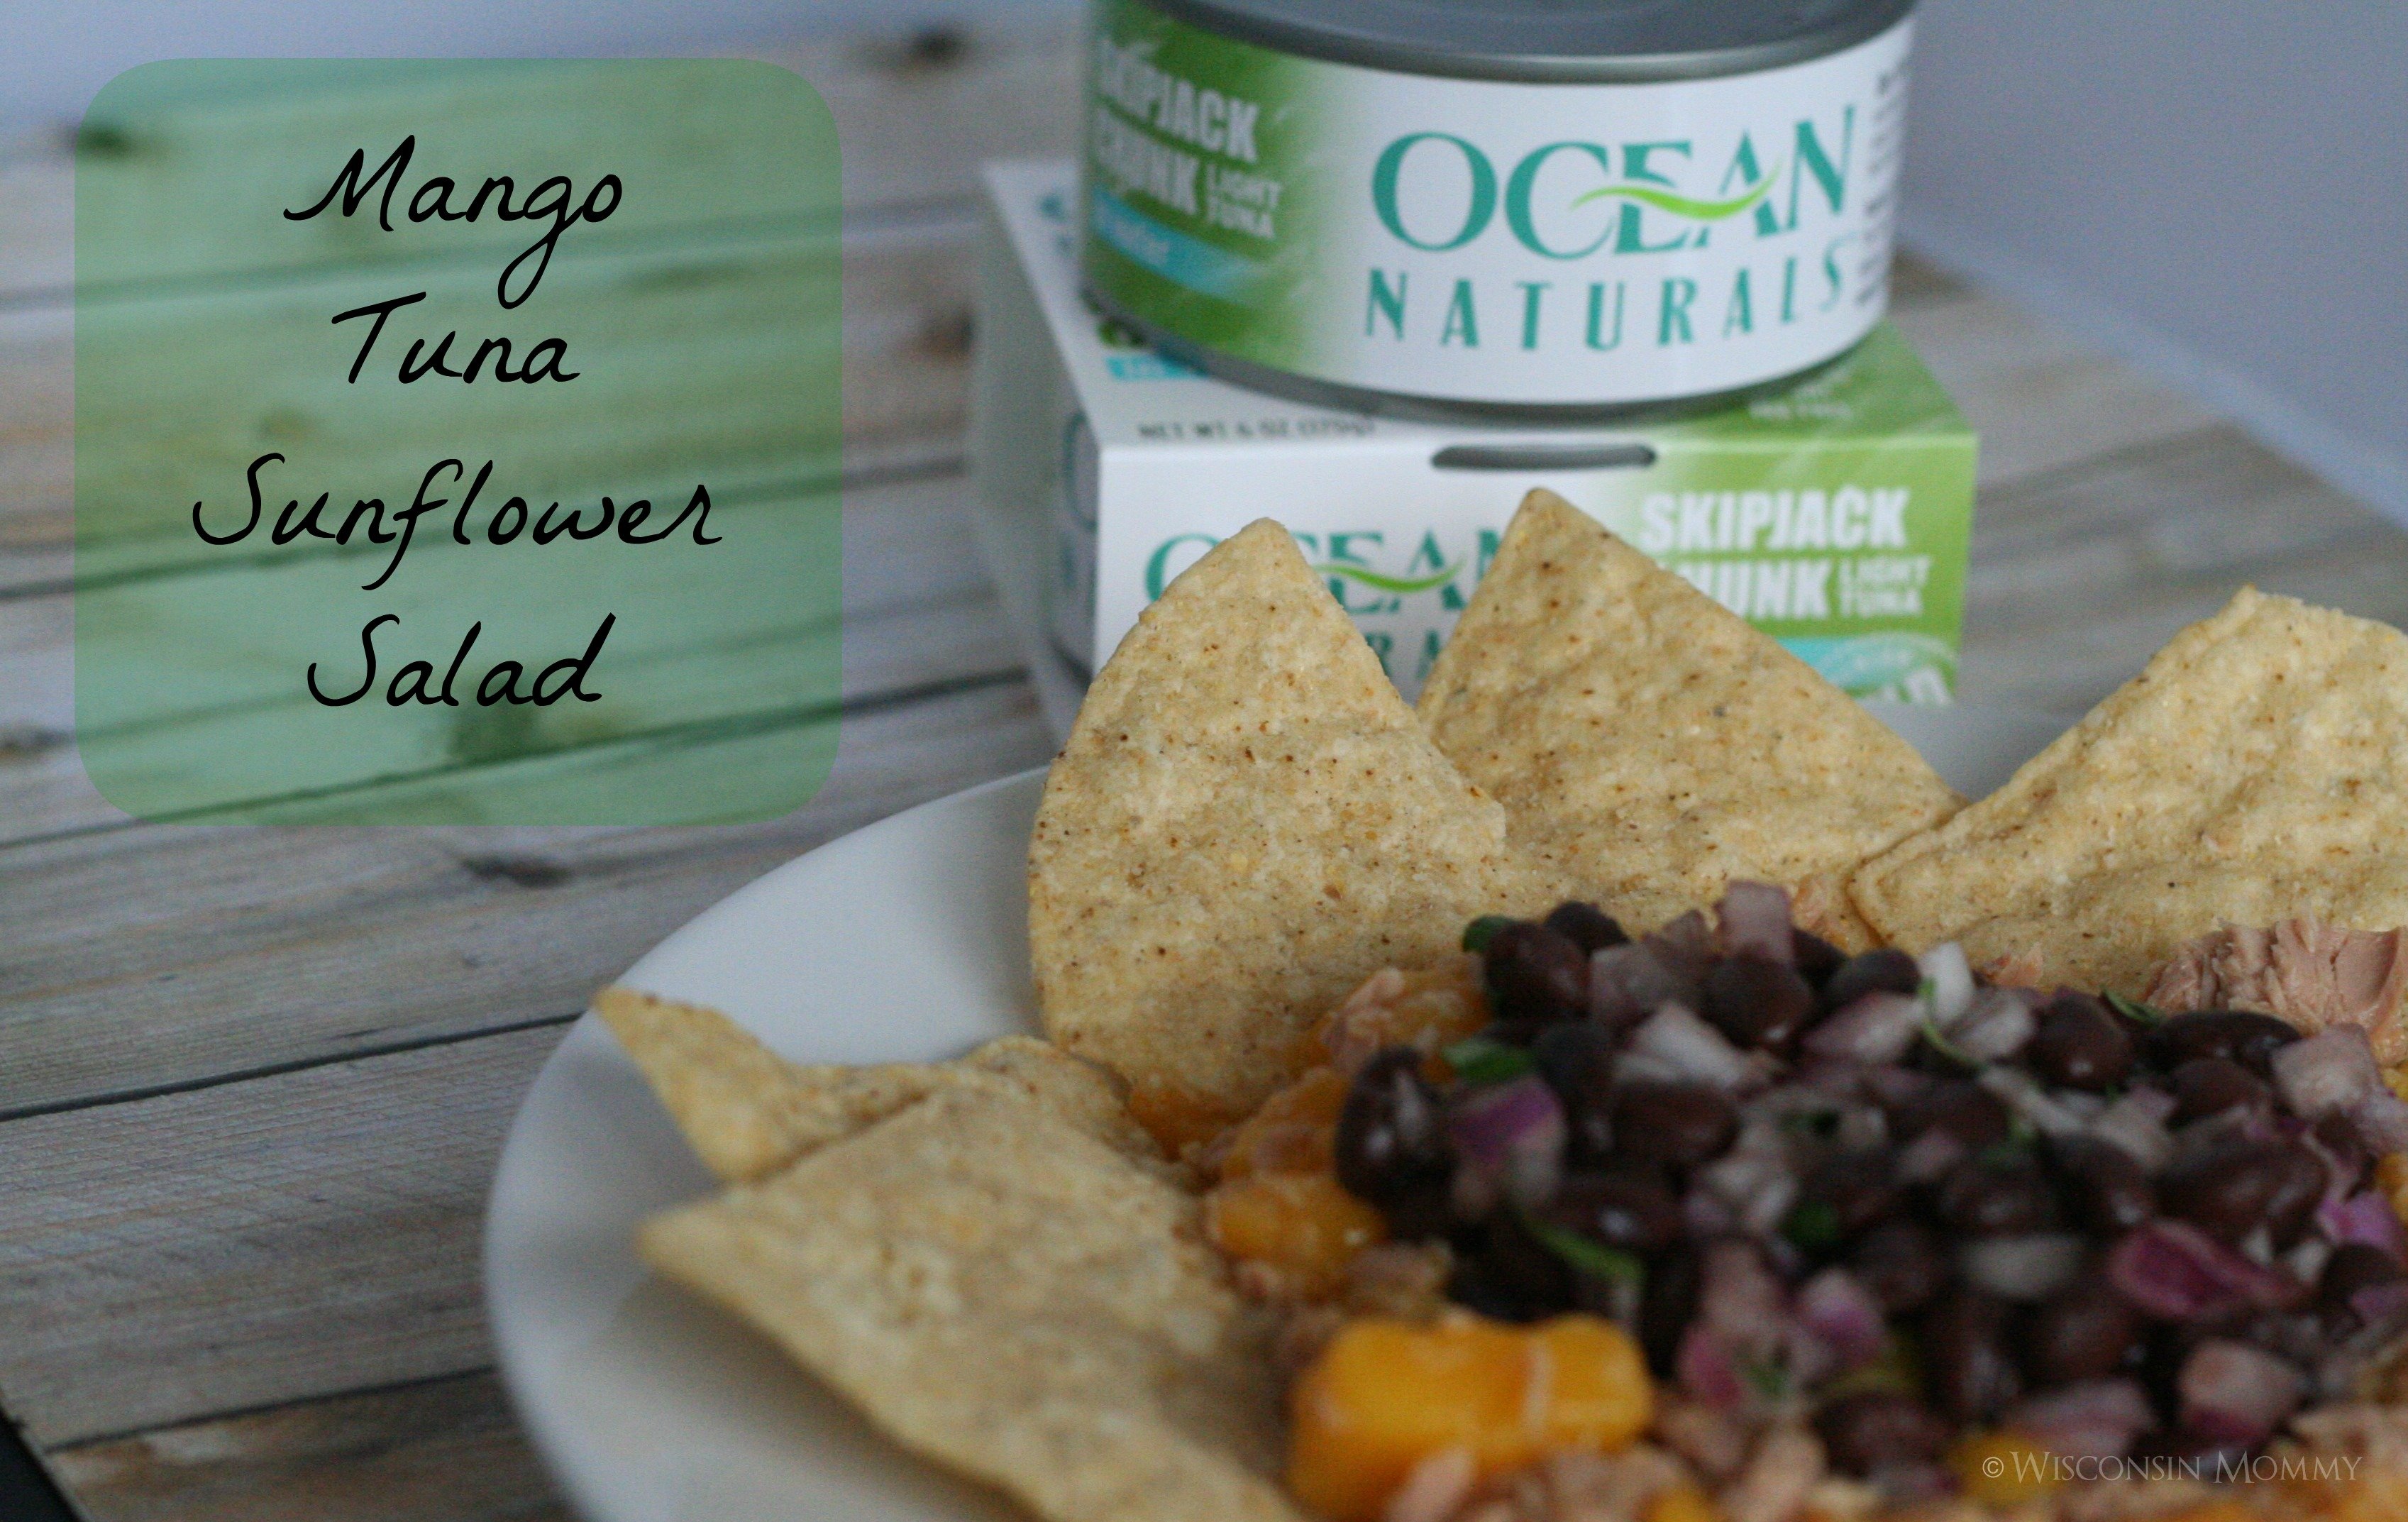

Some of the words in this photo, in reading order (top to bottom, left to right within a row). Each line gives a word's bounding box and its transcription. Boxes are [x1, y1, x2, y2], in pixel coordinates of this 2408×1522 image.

[1371, 104, 1854, 260] OCEAN
[1365, 231, 1859, 353] NATURALS
[1639, 485, 1911, 553] SKIPJACK
[1838, 588, 1923, 617] TUNA
[1839, 556, 1933, 586] LIGHT
